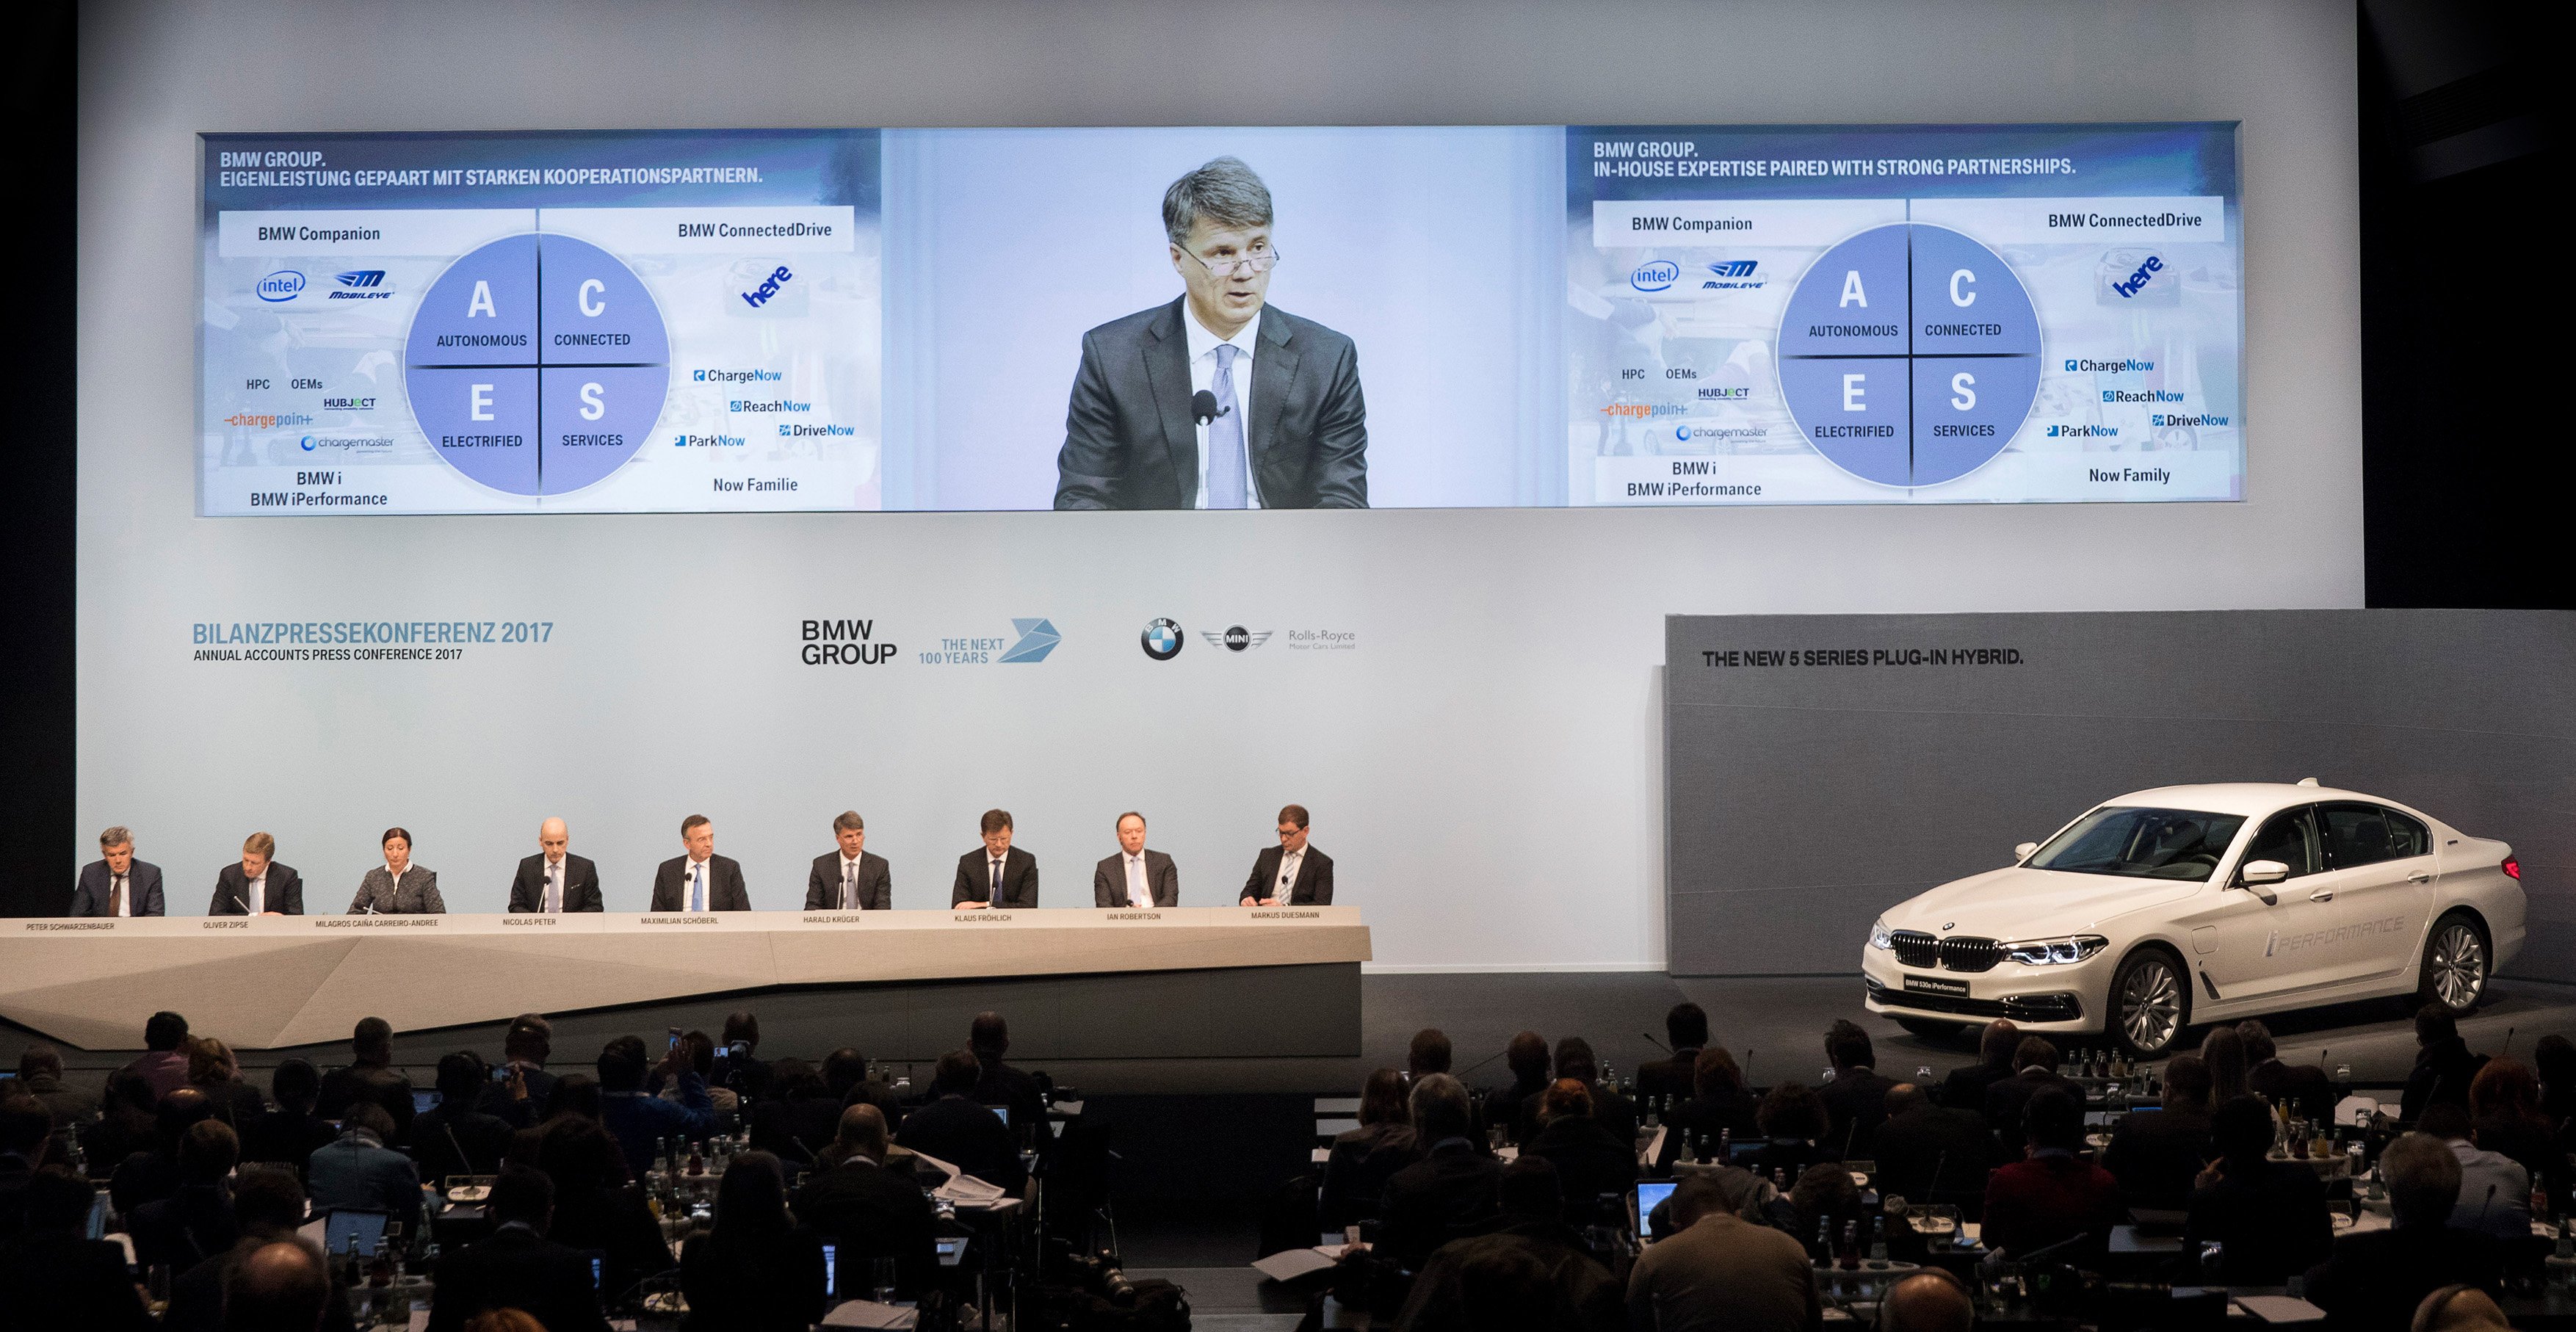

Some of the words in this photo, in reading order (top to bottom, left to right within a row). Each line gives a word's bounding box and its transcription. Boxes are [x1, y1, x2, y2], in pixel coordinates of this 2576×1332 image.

[1593, 142, 1634, 158] BMW
[1638, 142, 1698, 158] GROUP.
[220, 151, 261, 167] BMW
[264, 151, 326, 167] GROUP.
[1593, 161, 1674, 178] IN-HOUSE
[1678, 160, 1767, 177] EXPERTISE
[1770, 159, 1828, 176] PAIRED
[1831, 159, 1873, 176] WITH
[1877, 159, 1944, 175] STRONG
[1947, 158, 2077, 175] PARTNERSHIPS.
[220, 171, 351, 187] EIGENLEISTUNG
[354, 170, 430, 187] GEPAART
[433, 170, 463, 186] MIT
[466, 169, 541, 186] STARKEN
[544, 167, 763, 184] KOOPERATIONSPARTNERN.
[1632, 217, 1669, 231] BMW
[1673, 217, 1752, 233] Companion
[2049, 214, 2085, 228] BMW
[2089, 213, 2202, 228] ConnectedDrive
[258, 227, 296, 241] BMW
[300, 226, 380, 242] Companion
[679, 223, 715, 238] BMW
[719, 222, 832, 237] ConnectedDrive
[1636, 268, 1671, 283] intel
[2113, 256, 2163, 298] here
[263, 279, 297, 293] intel
[742, 265, 792, 308] here
[1839, 270, 1867, 308] A
[1950, 269, 1977, 308] C
[467, 280, 496, 318] A
[579, 278, 606, 317] C
[1809, 325, 1898, 337] AUTONOMOUS
[1925, 324, 2002, 336] CONNECTED
[436, 334, 527, 347] AUTONOMOUS
[554, 333, 631, 346] CONNECTED
[2080, 358, 2154, 374] ChargeNow
[708, 369, 782, 384] ChargeNow
[1621, 369, 1645, 380] HPC
[1665, 369, 1697, 380] OEMs
[247, 379, 270, 390] HPC
[291, 378, 323, 389] OEMs
[1843, 374, 1867, 411] E
[1950, 372, 1976, 411] S
[2116, 390, 2184, 403] ReachNow
[471, 384, 494, 421] E
[579, 383, 605, 421] S
[743, 400, 811, 413] ReachNow
[2166, 413, 2229, 427] DriveNow
[793, 424, 855, 437] DriveNow
[1693, 426, 1768, 440] chargemaster
[1815, 425, 1895, 438] ELECTRIFIED
[1933, 424, 1995, 437] SERVICES
[2061, 424, 2119, 438] ParkNow
[318, 436, 394, 450] chargemaster
[442, 435, 523, 448] ELECTRIFIED
[562, 434, 623, 446] SERVICES
[689, 434, 745, 447] ParkNow
[1672, 462, 1710, 475] BMW
[1712, 461, 1717, 474] i
[297, 472, 334, 485] BMW
[338, 471, 341, 485] i
[2089, 468, 2119, 482] Now
[2123, 468, 2171, 485] Family
[714, 479, 744, 491] Now
[748, 477, 797, 491] Familie
[1627, 482, 1664, 496] BMW
[1668, 481, 1762, 496] iPerformance
[250, 493, 289, 507] BMW
[292, 491, 388, 506] iPerformance
[193, 622, 496, 645] BILANZPRESSEKONFERENZ
[502, 621, 554, 643] 2017
[802, 619, 873, 641] BMW
[1289, 630, 1356, 643] Rolls-Royce
[942, 639, 968, 651] THE
[971, 638, 1005, 651] NEXT
[1226, 634, 1249, 643] MINI
[194, 649, 242, 661] ANNUAL
[244, 648, 310, 661] ACCOUNTS
[312, 648, 351, 660] PRESS
[353, 648, 433, 660] CONFERENCE
[435, 648, 463, 660] 2017
[801, 643, 897, 665] GROUP
[919, 652, 942, 665] 100
[945, 652, 989, 664] YEARS
[1702, 651, 1740, 667] THE
[1743, 650, 1786, 666] NEW
[1789, 651, 1800, 666] 5
[1803, 650, 1870, 666] SERIES
[1873, 649, 1947, 665] PLUG-IN
[1951, 648, 2024, 665] HYBRID.
[534, 918, 557, 926] PETER
[641, 917, 681, 925] MAXIMILIAN
[683, 916, 719, 924] SCHÖBERL
[803, 916, 831, 924] HARALD
[832, 914, 860, 923] KRÜGER
[954, 914, 977, 922] KLAUS
[978, 913, 1012, 922] FRÖHLICH
[1107, 913, 1118, 921] IAN
[1120, 912, 1161, 920] ROBERTSON
[1251, 911, 1280, 919] MARKUS
[1281, 911, 1320, 919] DUESMANN
[26, 922, 48, 930] PETER
[49, 922, 115, 930] SCHWARZENBAUER
[228, 921, 249, 929] ZIPSE
[315, 920, 351, 928] MILAGROS
[375, 919, 438, 927] CARREIRO-ANDREE
[1906, 979, 1919, 988] BMW
[1919, 980, 1931, 989] 530e
[1932, 982, 1966, 993] iPerformance
